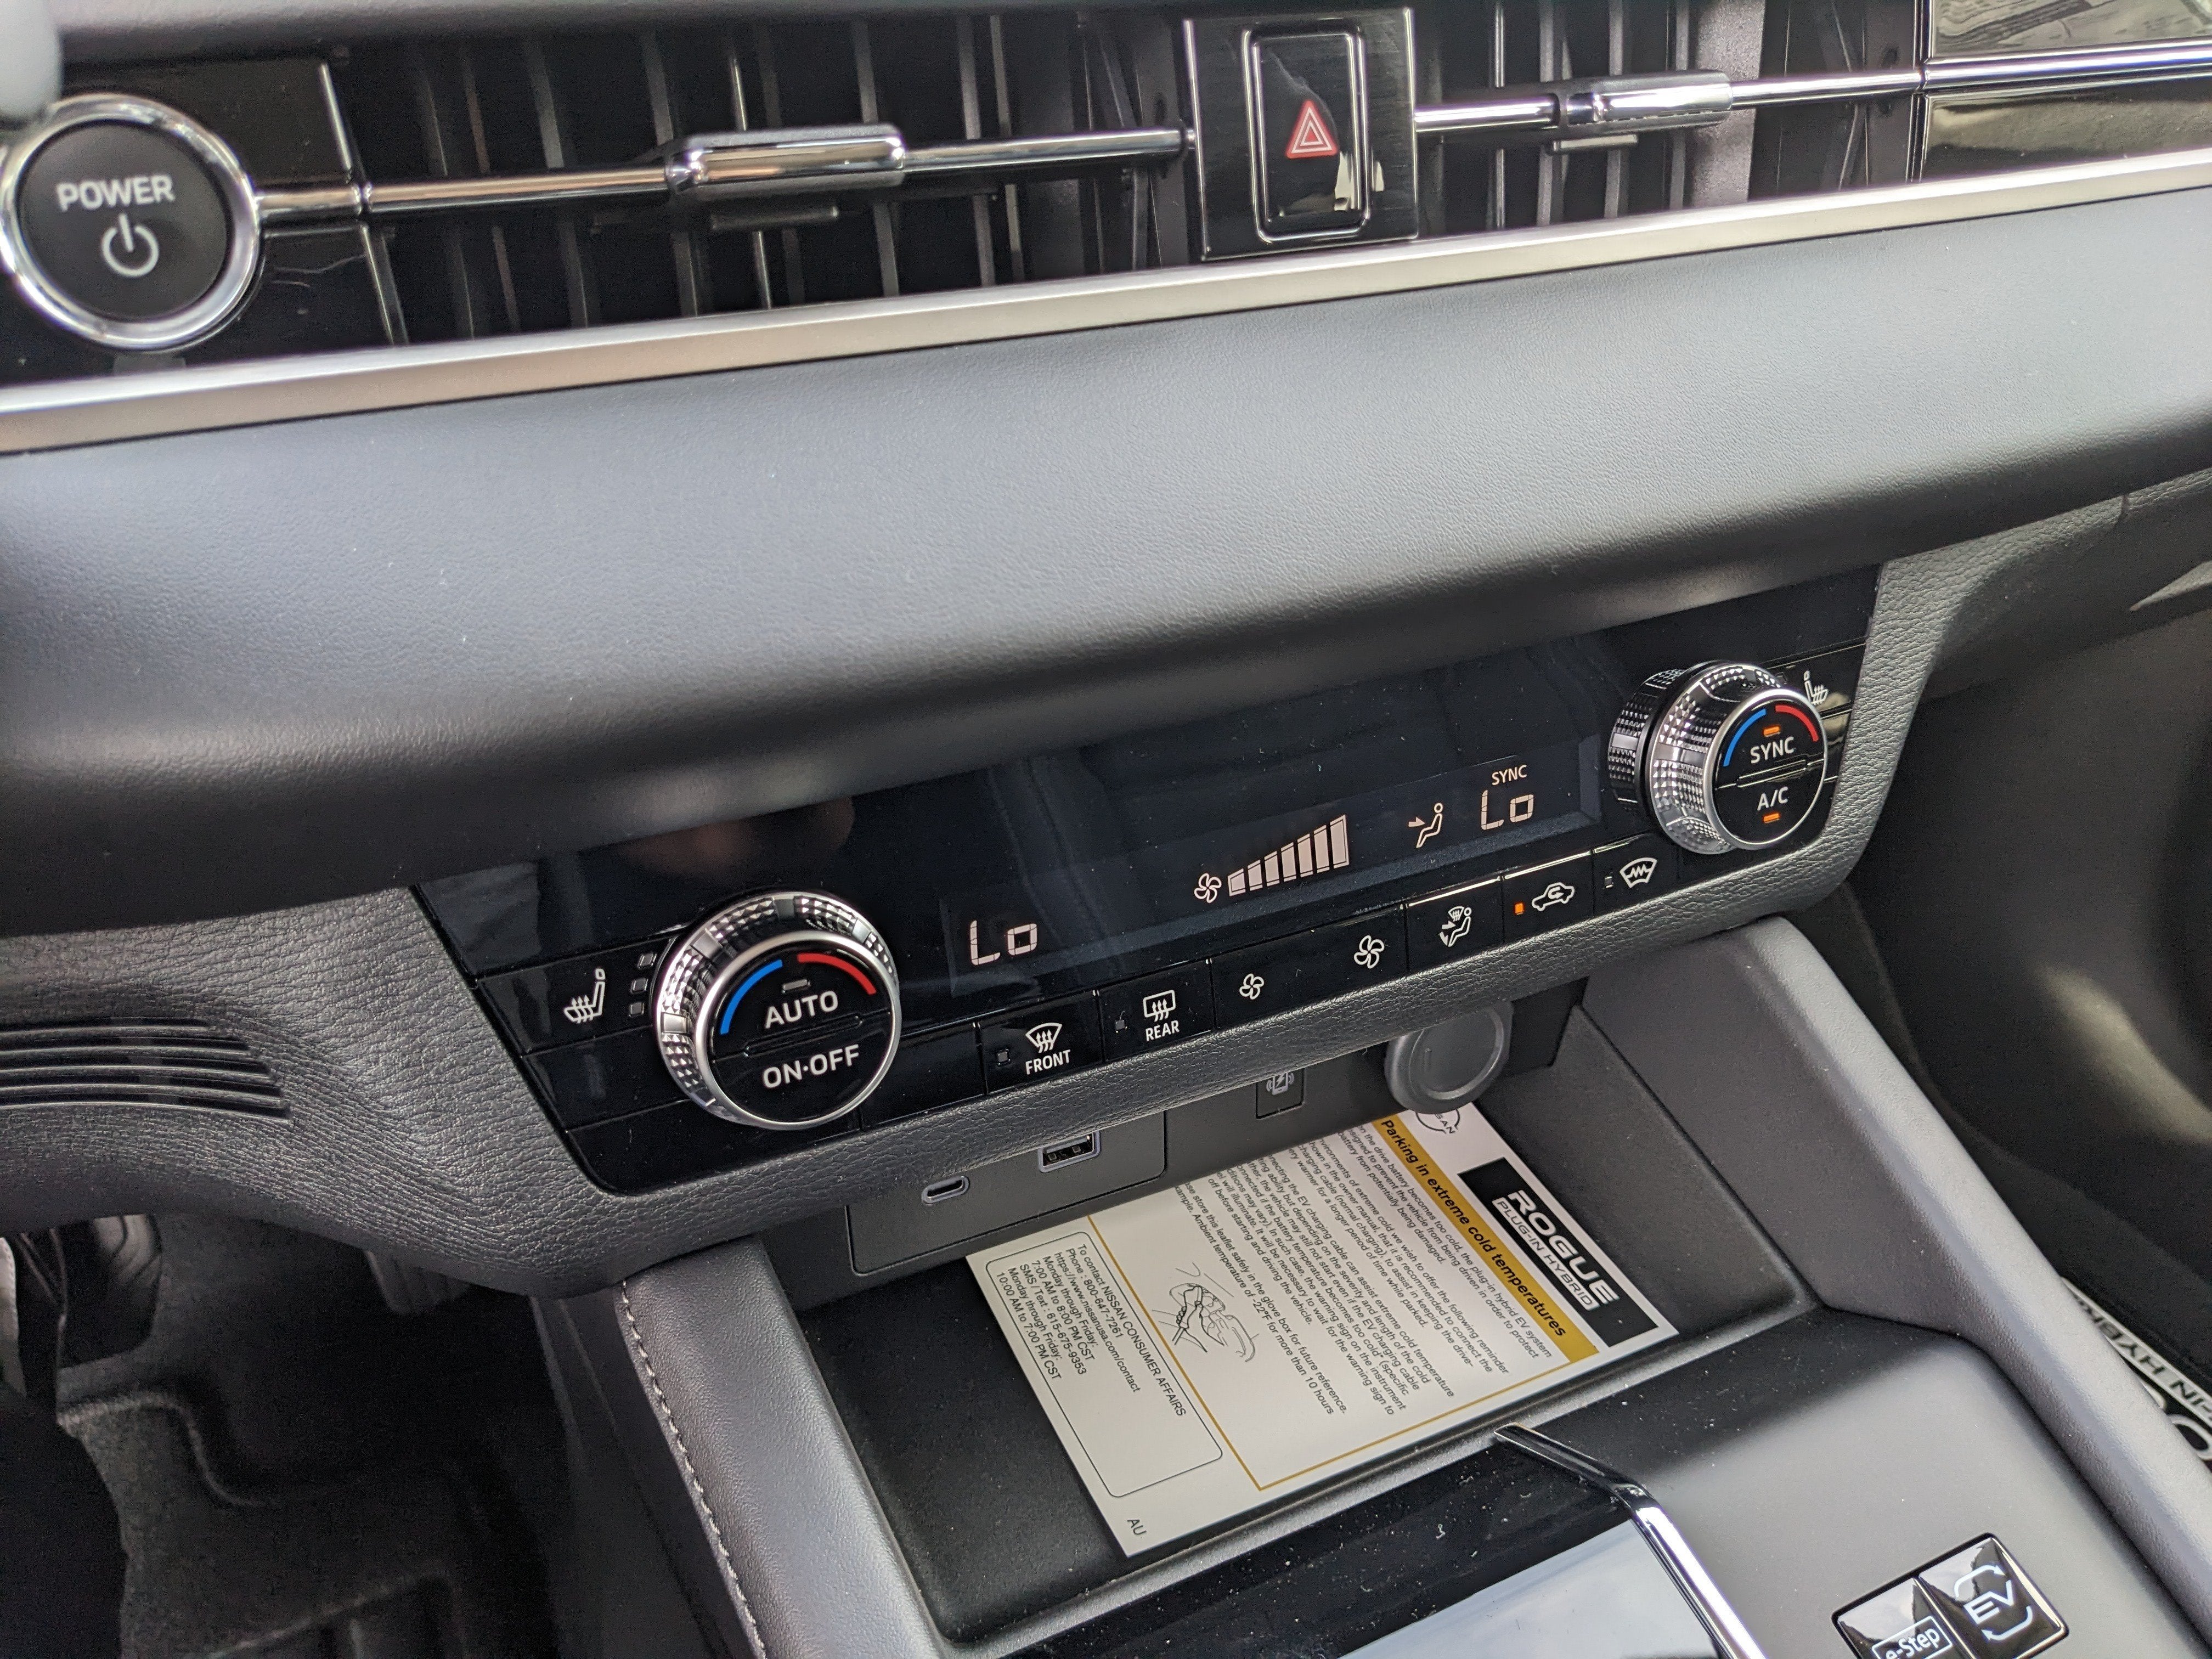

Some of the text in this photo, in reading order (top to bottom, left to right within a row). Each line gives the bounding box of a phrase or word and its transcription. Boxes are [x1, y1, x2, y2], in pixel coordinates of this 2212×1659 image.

[57, 174, 176, 212] POWER
[1492, 764, 1527, 786] SYNC
[1750, 737, 1795, 764] SYNC
[1481, 789, 1534, 830] Lo
[1757, 786, 1788, 811] A/C
[970, 920, 1037, 966] Lo
[765, 991, 839, 1029] AUTO
[1145, 1020, 1180, 1042] REAR
[1025, 1049, 1071, 1075] FRONT
[1380, 1119, 1567, 1336] Parking in extreme cold temperatures
[1496, 1200, 1594, 1306] PLUG-IN HYBRID
[1507, 1189, 1620, 1305] ROGUE
[996, 1272, 1063, 1380] 10:00 AM to 7:00 PM CST
[1007, 1266, 1063, 1361] Monday through Friday:
[1019, 1263, 1038, 1285] SMS
[1034, 1289, 1049, 1308] Text
[1046, 1312, 1087, 1375] 615-675-9353
[1031, 1259, 1096, 1361] 7:00 AM to 8:00 PM CST
[1042, 1255, 1099, 1348] Monday through Friday:
[1053, 1251, 1142, 1393] https://www.nissanusa.com/contact
[1065, 1247, 1085, 1274] Phone
[1082, 1278, 1125, 1339] 800-647-7261
[1212, 1243, 1247, 1289] temperature
[1243, 1289, 1257, 1298] of
[1266, 1321, 1279, 1334] for
[1274, 1334, 1294, 1356] more
[1290, 1356, 1307, 1376] than
[1305, 1376, 1319, 1389] 10
[1313, 1388, 1335, 1415] hours
[1250, 1240, 1313, 1325] and driving the vehicle.
[1260, 1234, 1395, 1415] will be necessary to wait for the warning sign to
[1274, 1237, 1407, 1410] such case, the warning sign on the instrument
[1291, 1242, 1328, 1288] temperature
[1324, 1286, 1355, 1324] becomes
[1351, 1323, 1366, 1338] too
[1378, 1359, 1409, 1396] (specific
[1308, 1247, 1323, 1261] not
[1318, 1261, 1336, 1279] start
[1331, 1279, 1350, 1298] even
[1351, 1304, 1365, 1319] the
[1361, 1318, 1378, 1330] EV
[1372, 1331, 1402, 1368] charging
[1398, 1367, 1420, 1391] cable
[1321, 1245, 1432, 1384] on the severity and length of the cold
[1345, 1260, 1455, 1397] can assist extreme cold temperature
[1365, 1251, 1429, 1328] of time while parked.
[1384, 1257, 1395, 1268] to
[1391, 1267, 1414, 1291] assist
[1409, 1289, 1419, 1299] in
[1415, 1297, 1444, 1331] keeping
[1440, 1329, 1455, 1344] the
[1389, 1246, 1493, 1373] it is recommended to connect the
[1414, 1262, 1510, 1374] to offer the following reminder
[1458, 1266, 1540, 1359] driven in order to protect
[1468, 1266, 1553, 1358] plug-in hybrid EV system
[1076, 1243, 1187, 1417] To contact NISSAN CONSUMER AFFAIRS
[1231, 1251, 1347, 1414] safely in the glove box for future reference.
[1126, 1519, 1148, 1536] AU
[1886, 1627, 1940, 1659] e-Step
[1963, 1579, 2015, 1624] EV
